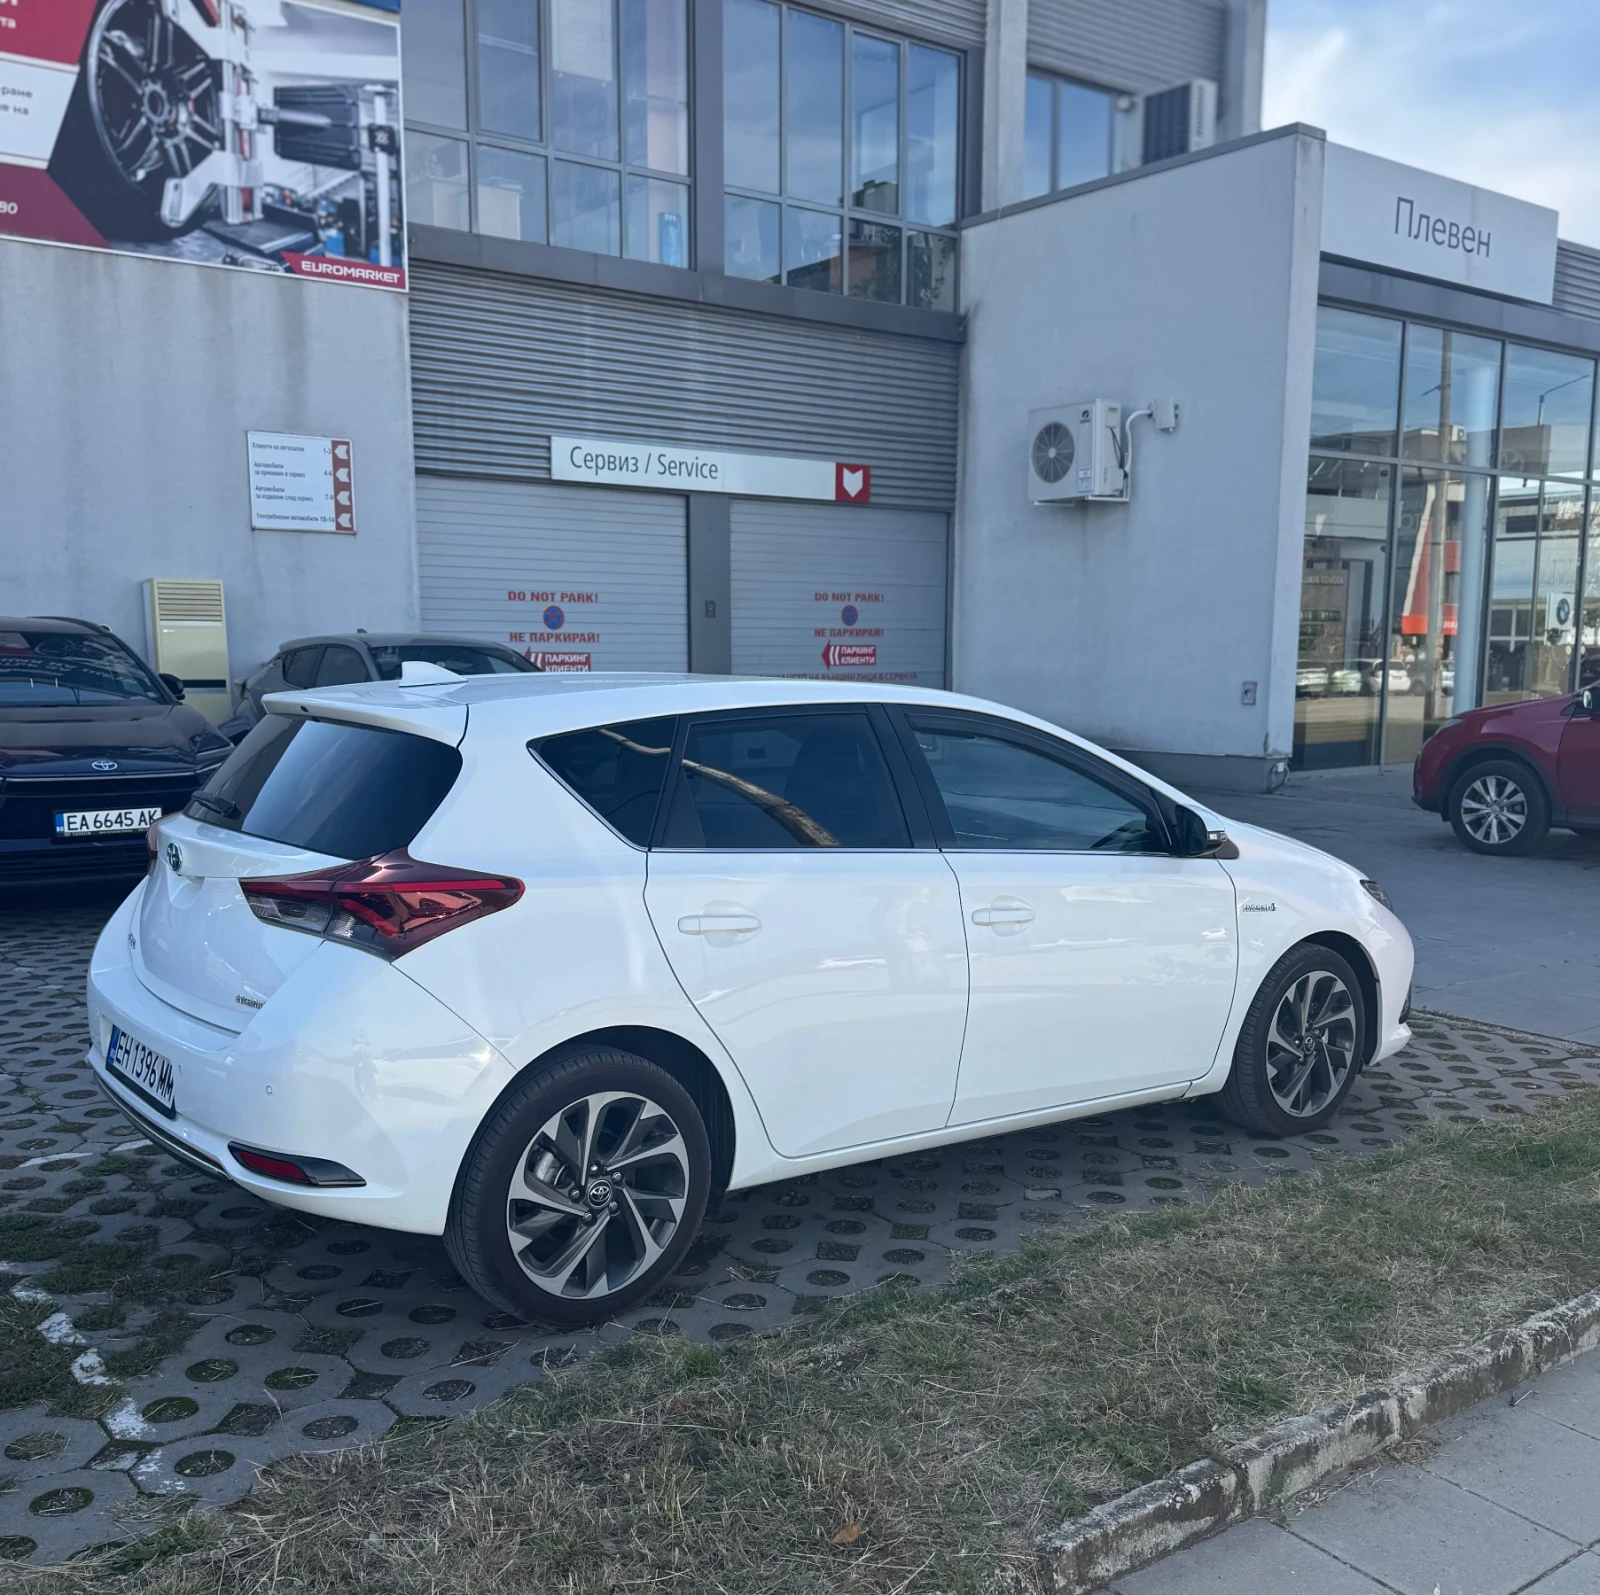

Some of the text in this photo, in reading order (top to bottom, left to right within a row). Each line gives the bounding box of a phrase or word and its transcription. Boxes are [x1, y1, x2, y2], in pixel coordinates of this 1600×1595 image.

[1394, 196, 1491, 258] Плевен
[300, 260, 400, 284] EUROMARKET
[254, 461, 284, 469] Автомобили
[569, 445, 719, 480] Сервиз / Service
[508, 591, 599, 603] DO NOT PARK!
[814, 592, 884, 603] DO NOT PARK!
[509, 632, 600, 644] НЕ ПАРКИРАЙ!
[814, 628, 884, 638] НЕ ПАРКИРАЙ!
[841, 646, 876, 654] ПАРКИНГ
[545, 653, 589, 663] ПАРКИНГ
[841, 656, 876, 665] КЛИЕНТИ
[545, 665, 589, 673] КЛИЕНТИ
[66, 809, 158, 832] EA 6645 AK
[115, 1030, 174, 1103] EH 1396 MM
